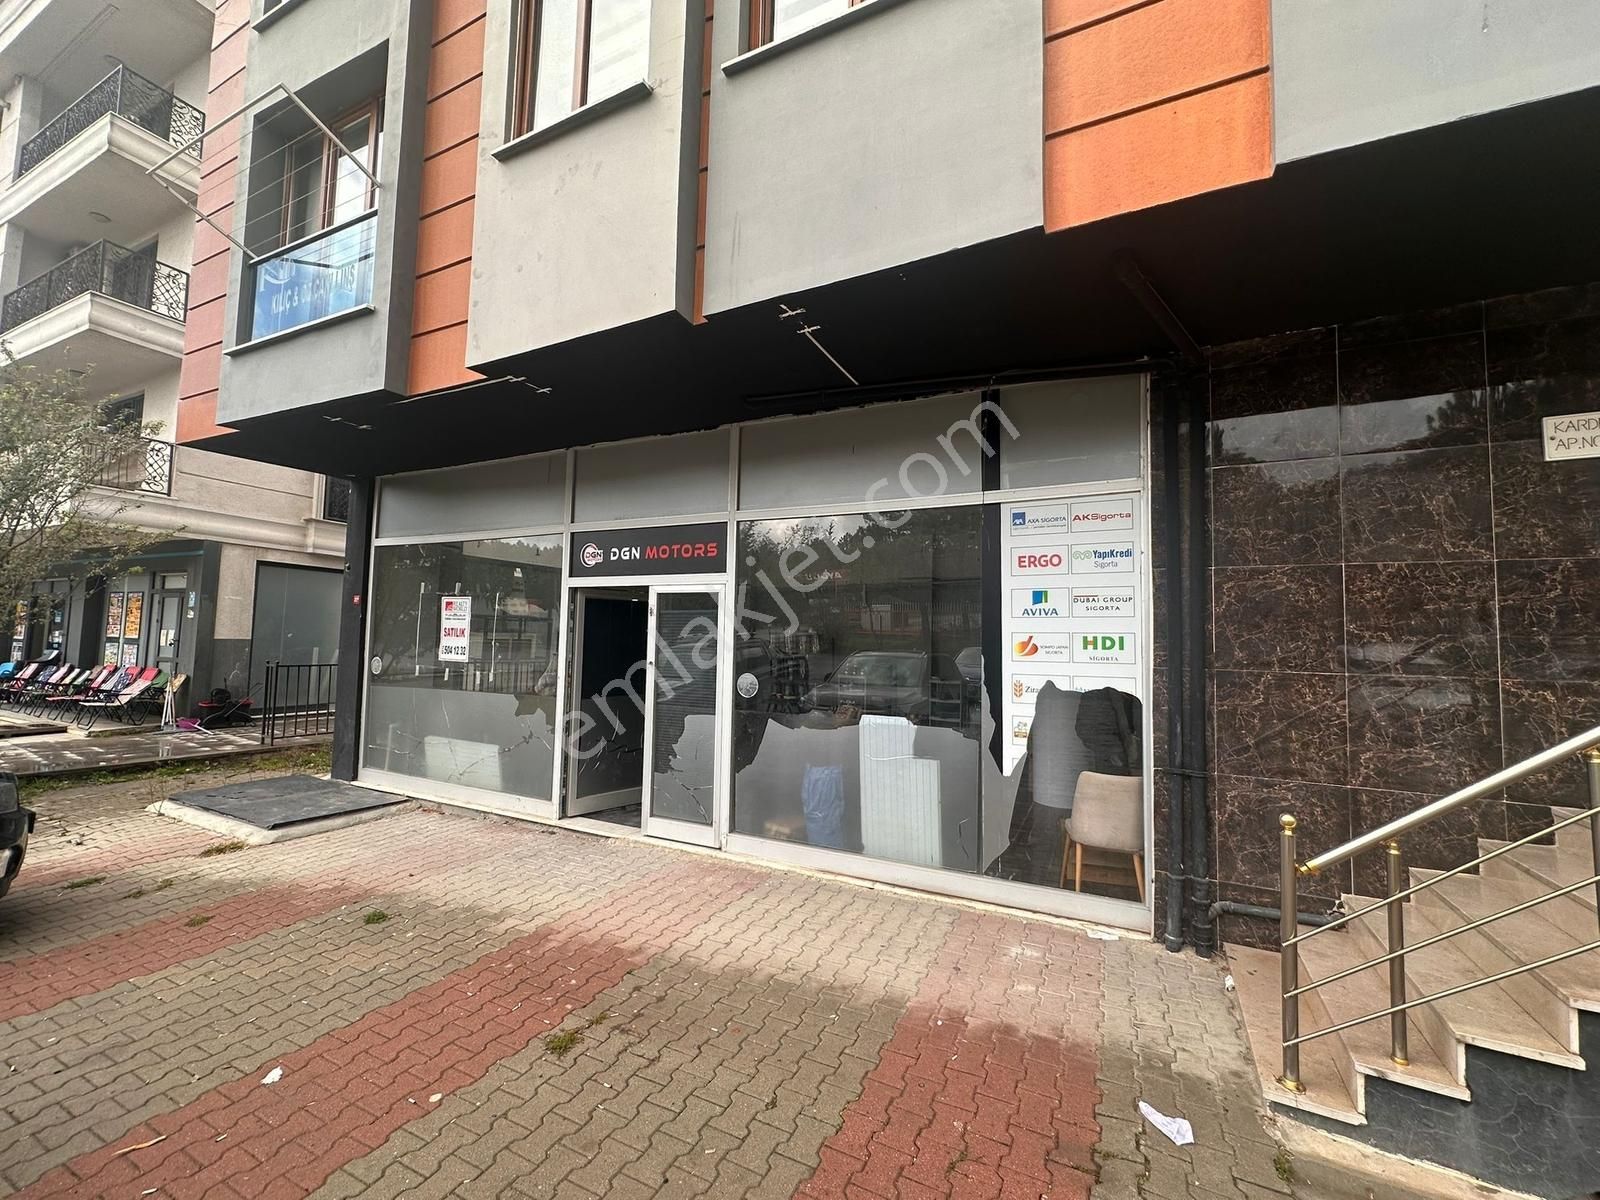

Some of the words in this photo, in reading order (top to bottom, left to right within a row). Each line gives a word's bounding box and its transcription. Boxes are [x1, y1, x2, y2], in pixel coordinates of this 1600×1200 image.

[1072, 512, 1131, 522] AKSigorta
[585, 551, 602, 559] DGN
[610, 546, 640, 561] DGN
[645, 542, 718, 559] MOTORS
[1017, 553, 1062, 568] ERGO
[1093, 560, 1118, 569] Sigorta
[1022, 607, 1059, 617] AVIVA
[443, 627, 466, 638] SATILIK
[1082, 635, 1125, 651] HDI
[444, 645, 453, 655] 504
[453, 645, 460, 655] 12
[460, 646, 466, 656] 32
